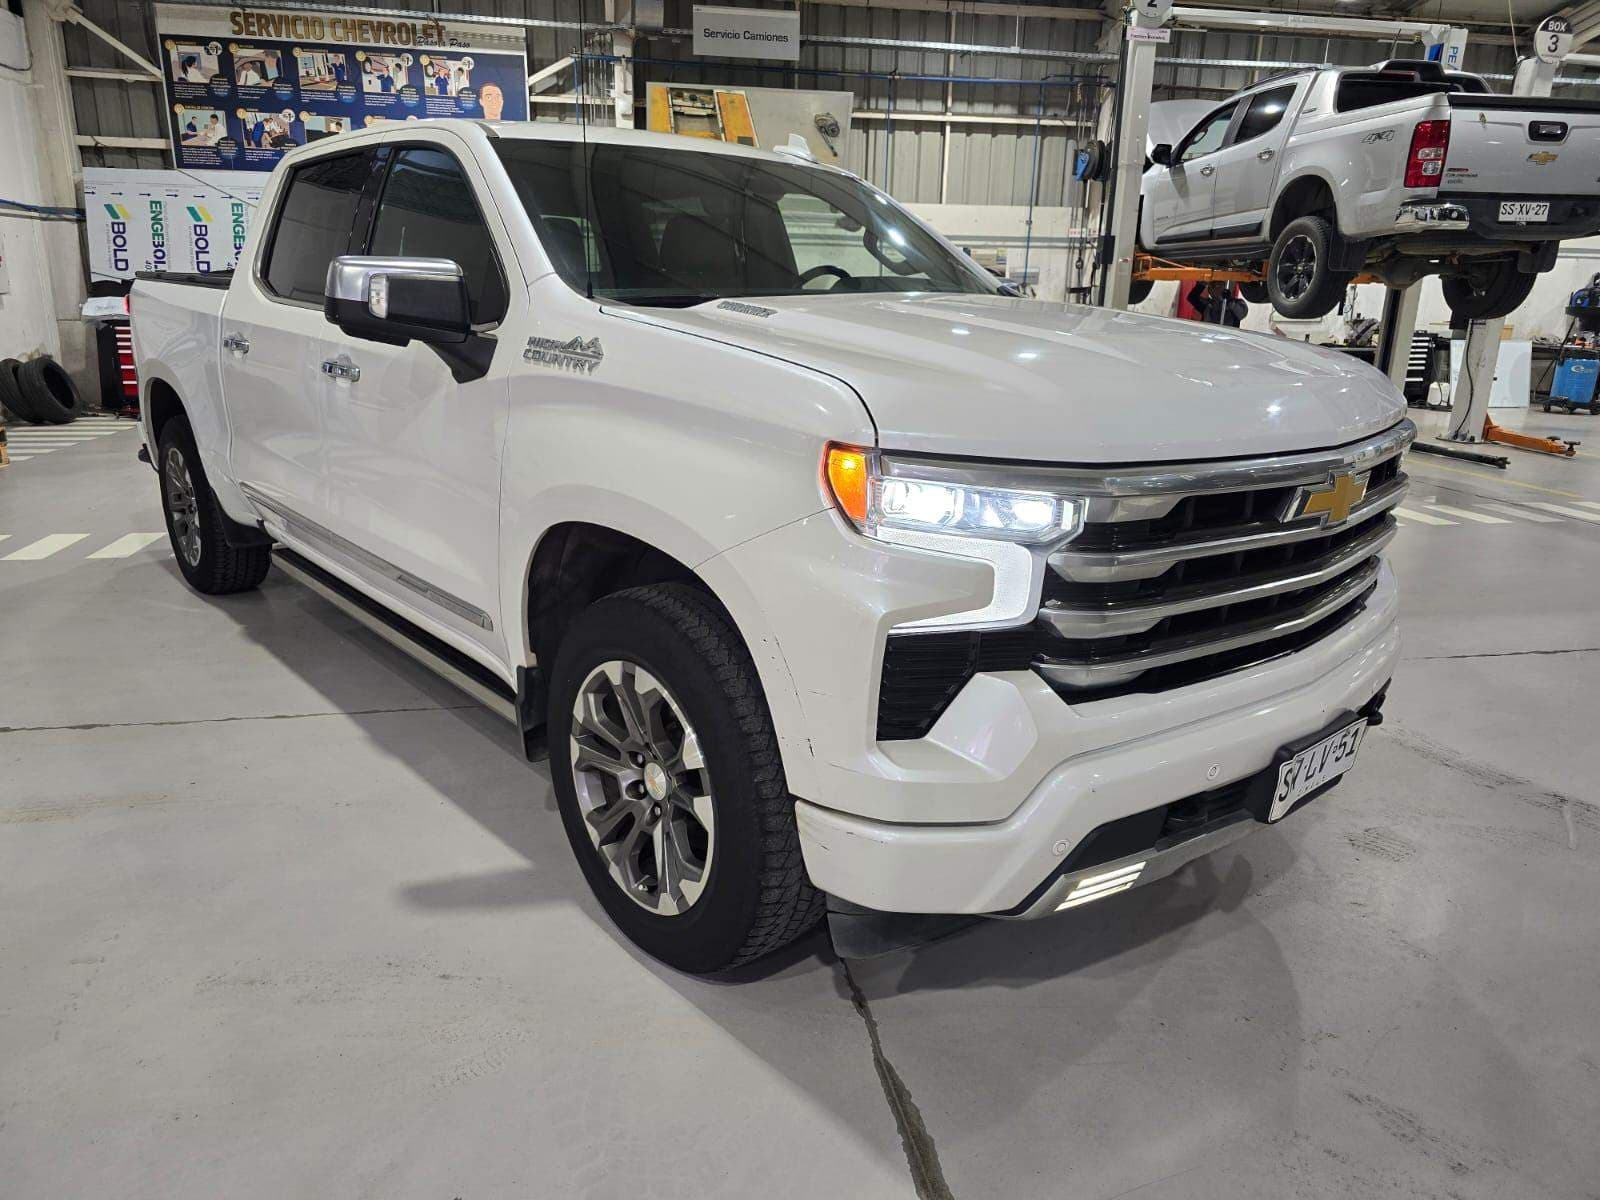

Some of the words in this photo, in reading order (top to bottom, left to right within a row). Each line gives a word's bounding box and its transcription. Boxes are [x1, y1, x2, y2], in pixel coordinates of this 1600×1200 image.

[229, 11, 325, 41] SERVICIO
[329, 17, 446, 48] CHEVROLET
[703, 28, 741, 40] Servicio
[743, 30, 789, 43] Camiones
[1548, 20, 1568, 32] BOX
[449, 38, 472, 48] Paso
[1547, 34, 1560, 53] 3
[111, 222, 129, 272] BOLD
[194, 224, 211, 277] BOLD
[522, 348, 602, 376] COUNTRY
